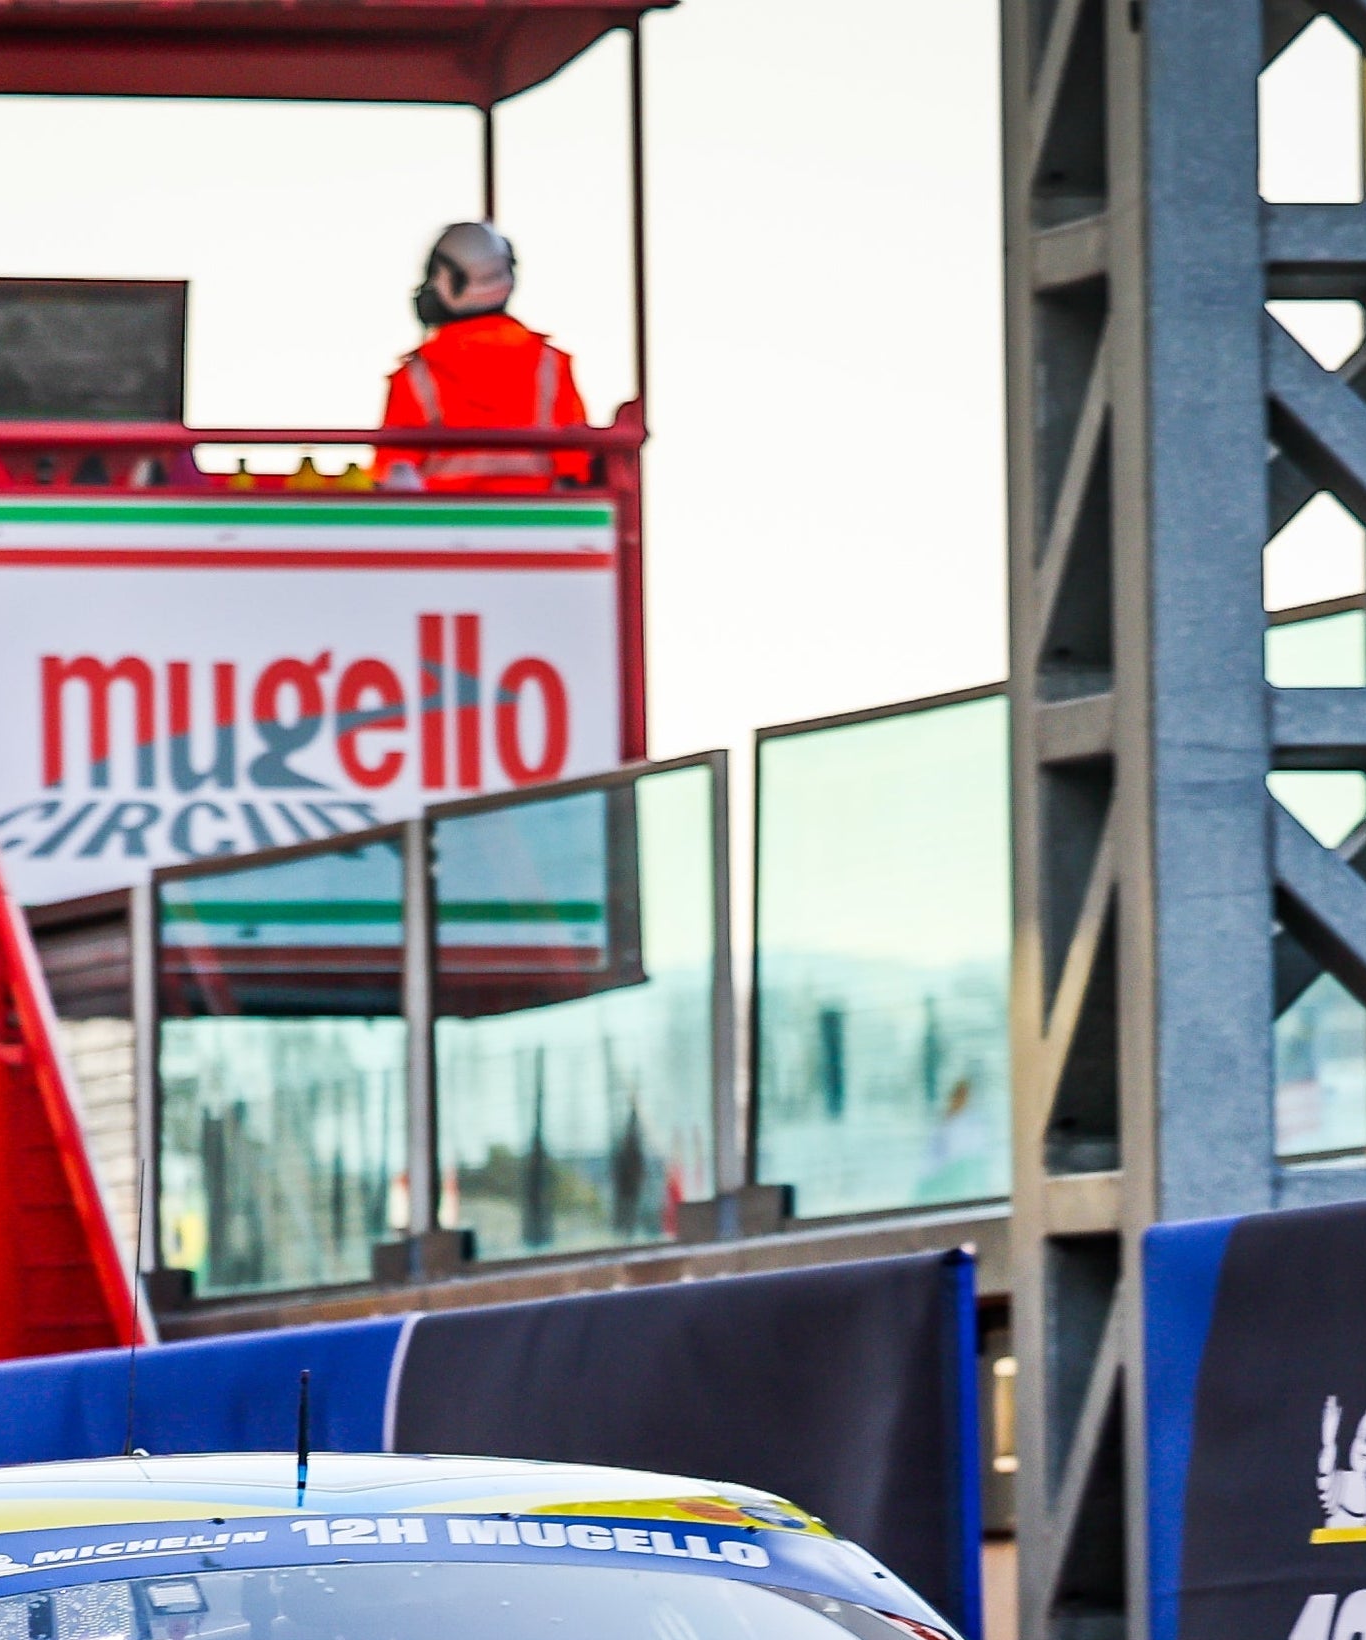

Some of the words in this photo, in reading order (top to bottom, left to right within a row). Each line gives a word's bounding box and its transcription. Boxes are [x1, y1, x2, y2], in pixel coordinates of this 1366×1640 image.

[41, 612, 569, 794] mugello
[32, 1530, 268, 1565] MICHELIN
[290, 1517, 428, 1547] 12H
[446, 1517, 772, 1570] MUGELLO
